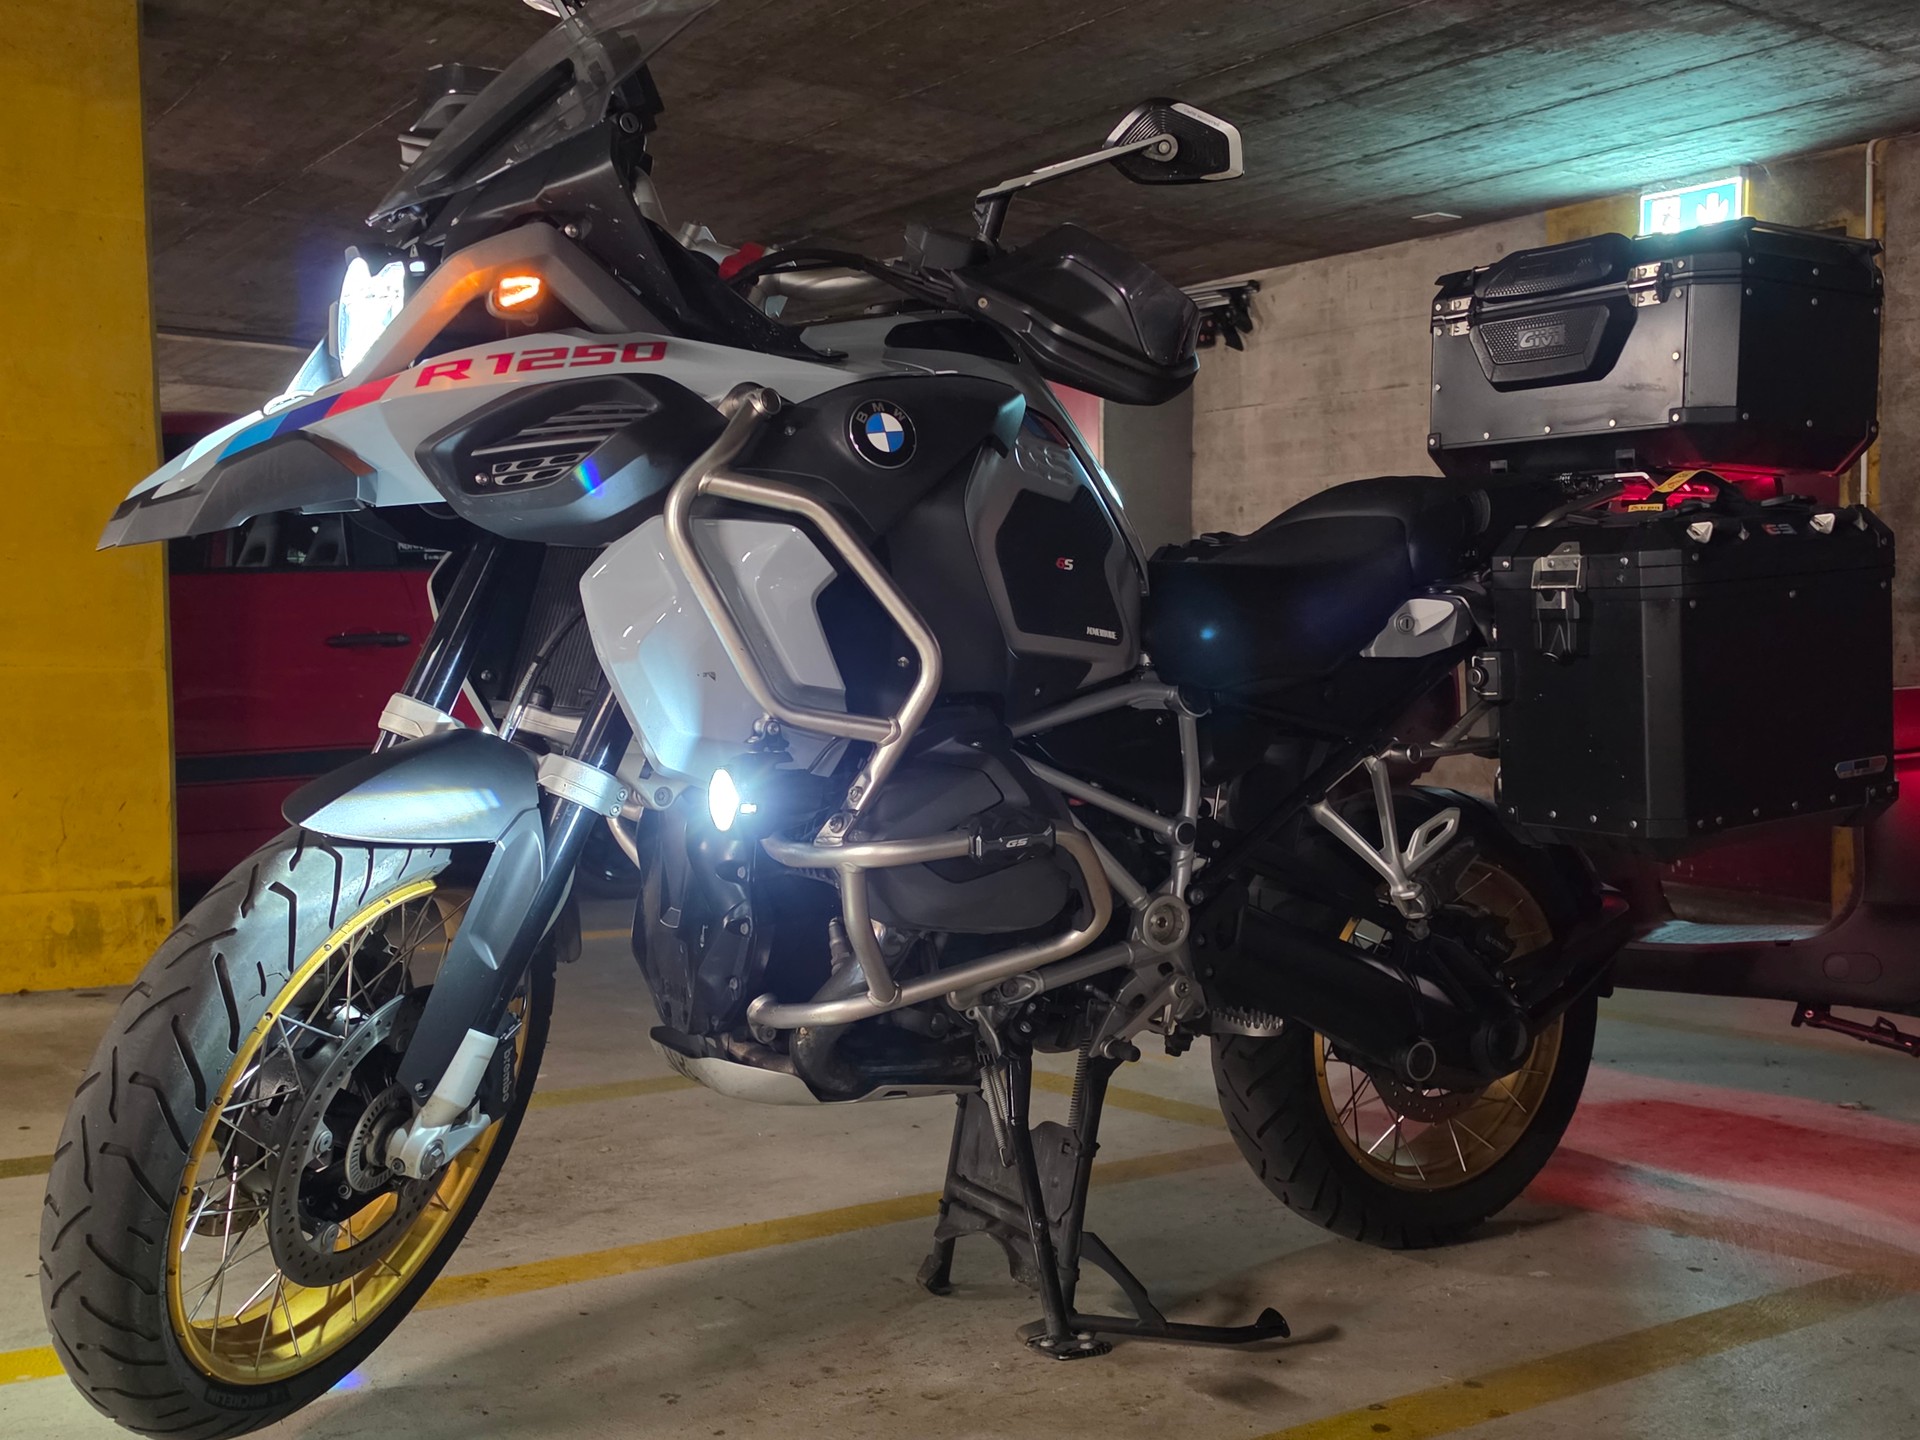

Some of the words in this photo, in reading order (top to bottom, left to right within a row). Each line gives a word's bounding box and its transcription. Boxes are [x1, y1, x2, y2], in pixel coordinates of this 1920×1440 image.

[415, 359, 473, 388] R
[486, 342, 668, 375] 1250
[855, 402, 906, 424] BMW
[1006, 837, 1029, 848] GS
[502, 1045, 514, 1103] brembo
